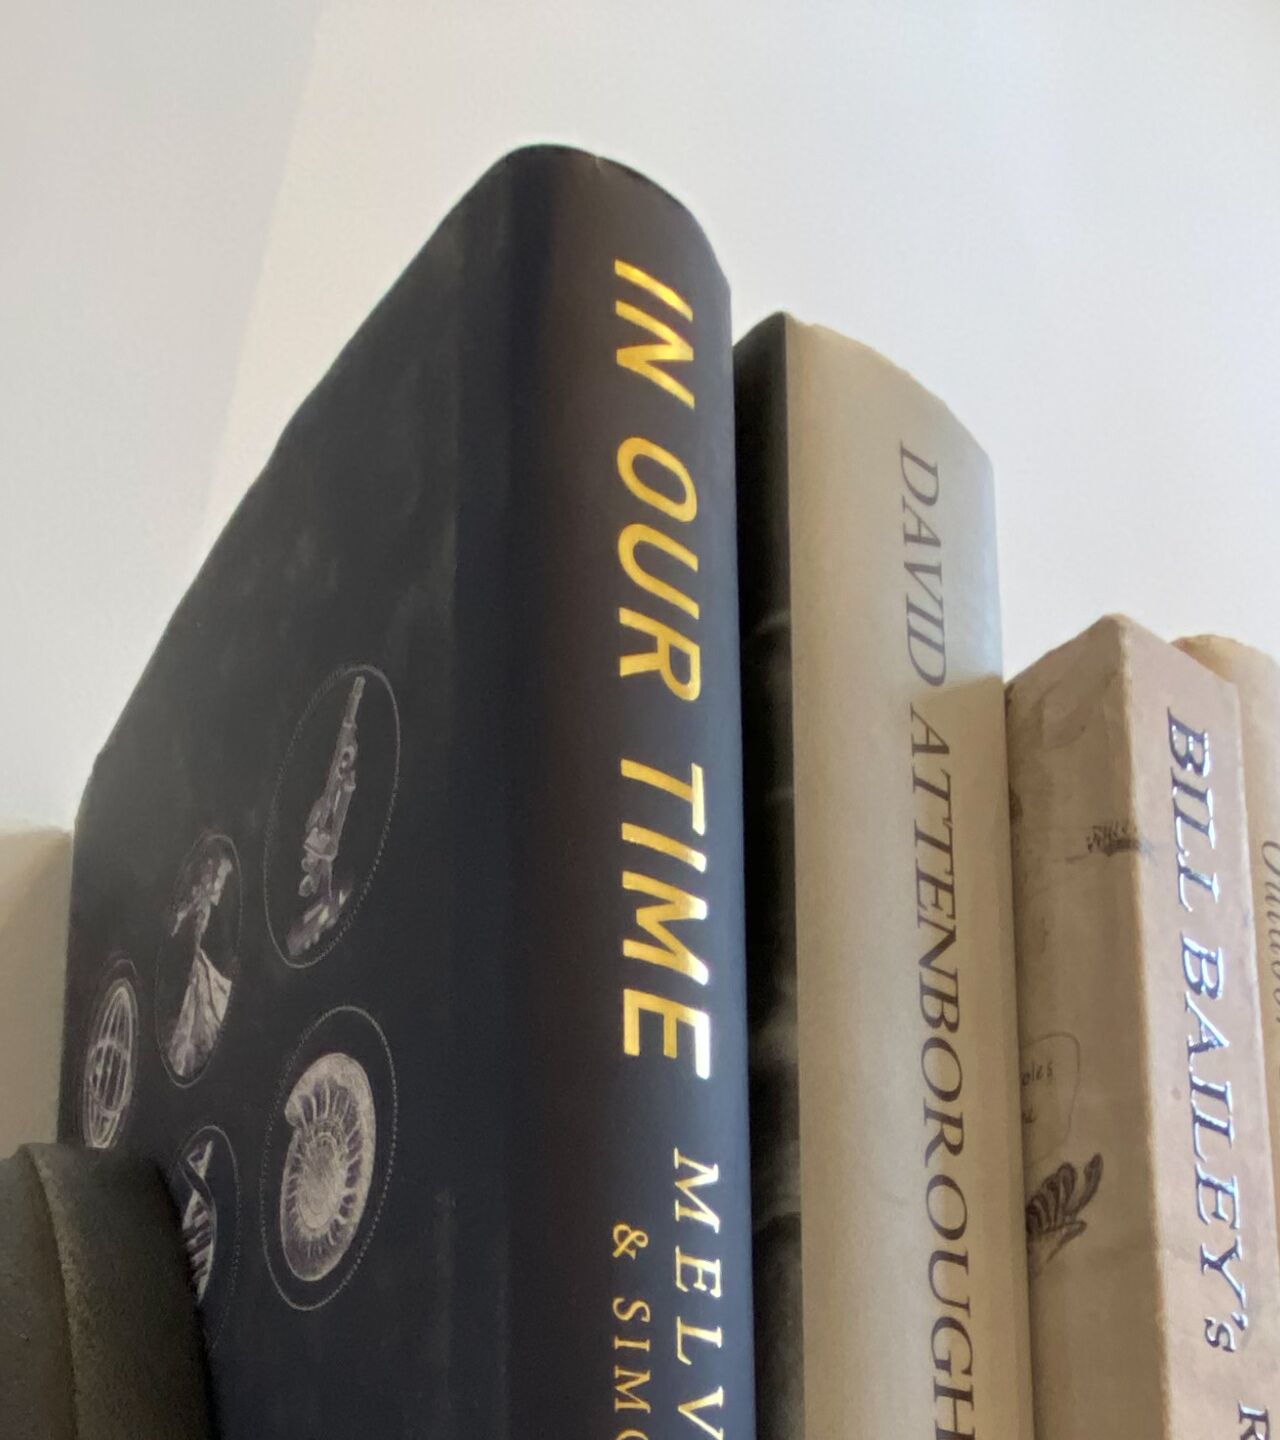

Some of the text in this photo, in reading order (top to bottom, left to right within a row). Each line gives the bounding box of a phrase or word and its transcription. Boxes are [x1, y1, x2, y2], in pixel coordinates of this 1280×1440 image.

[613, 258, 711, 1081] IN OUR TIME
[900, 439, 947, 688] DAVID
[1167, 706, 1220, 912] BILL
[612, 1223, 649, 1261] &
